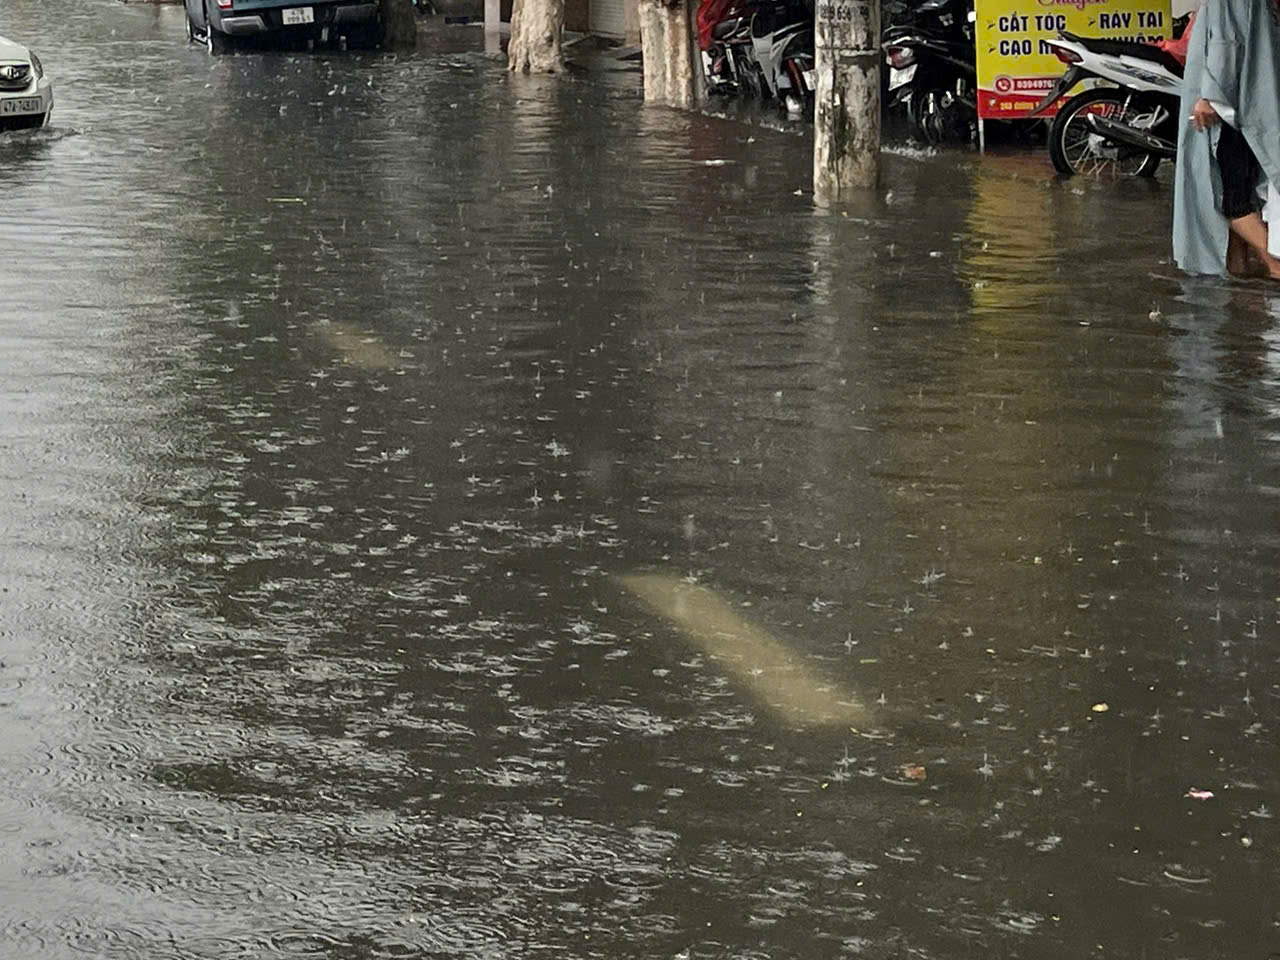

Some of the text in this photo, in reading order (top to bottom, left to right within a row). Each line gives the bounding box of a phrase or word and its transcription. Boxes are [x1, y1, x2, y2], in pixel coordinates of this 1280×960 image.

[998, 11, 1066, 32] CẮT TÓC
[1099, 10, 1163, 29] RÁY TAI
[999, 39, 1033, 59] CẠO
